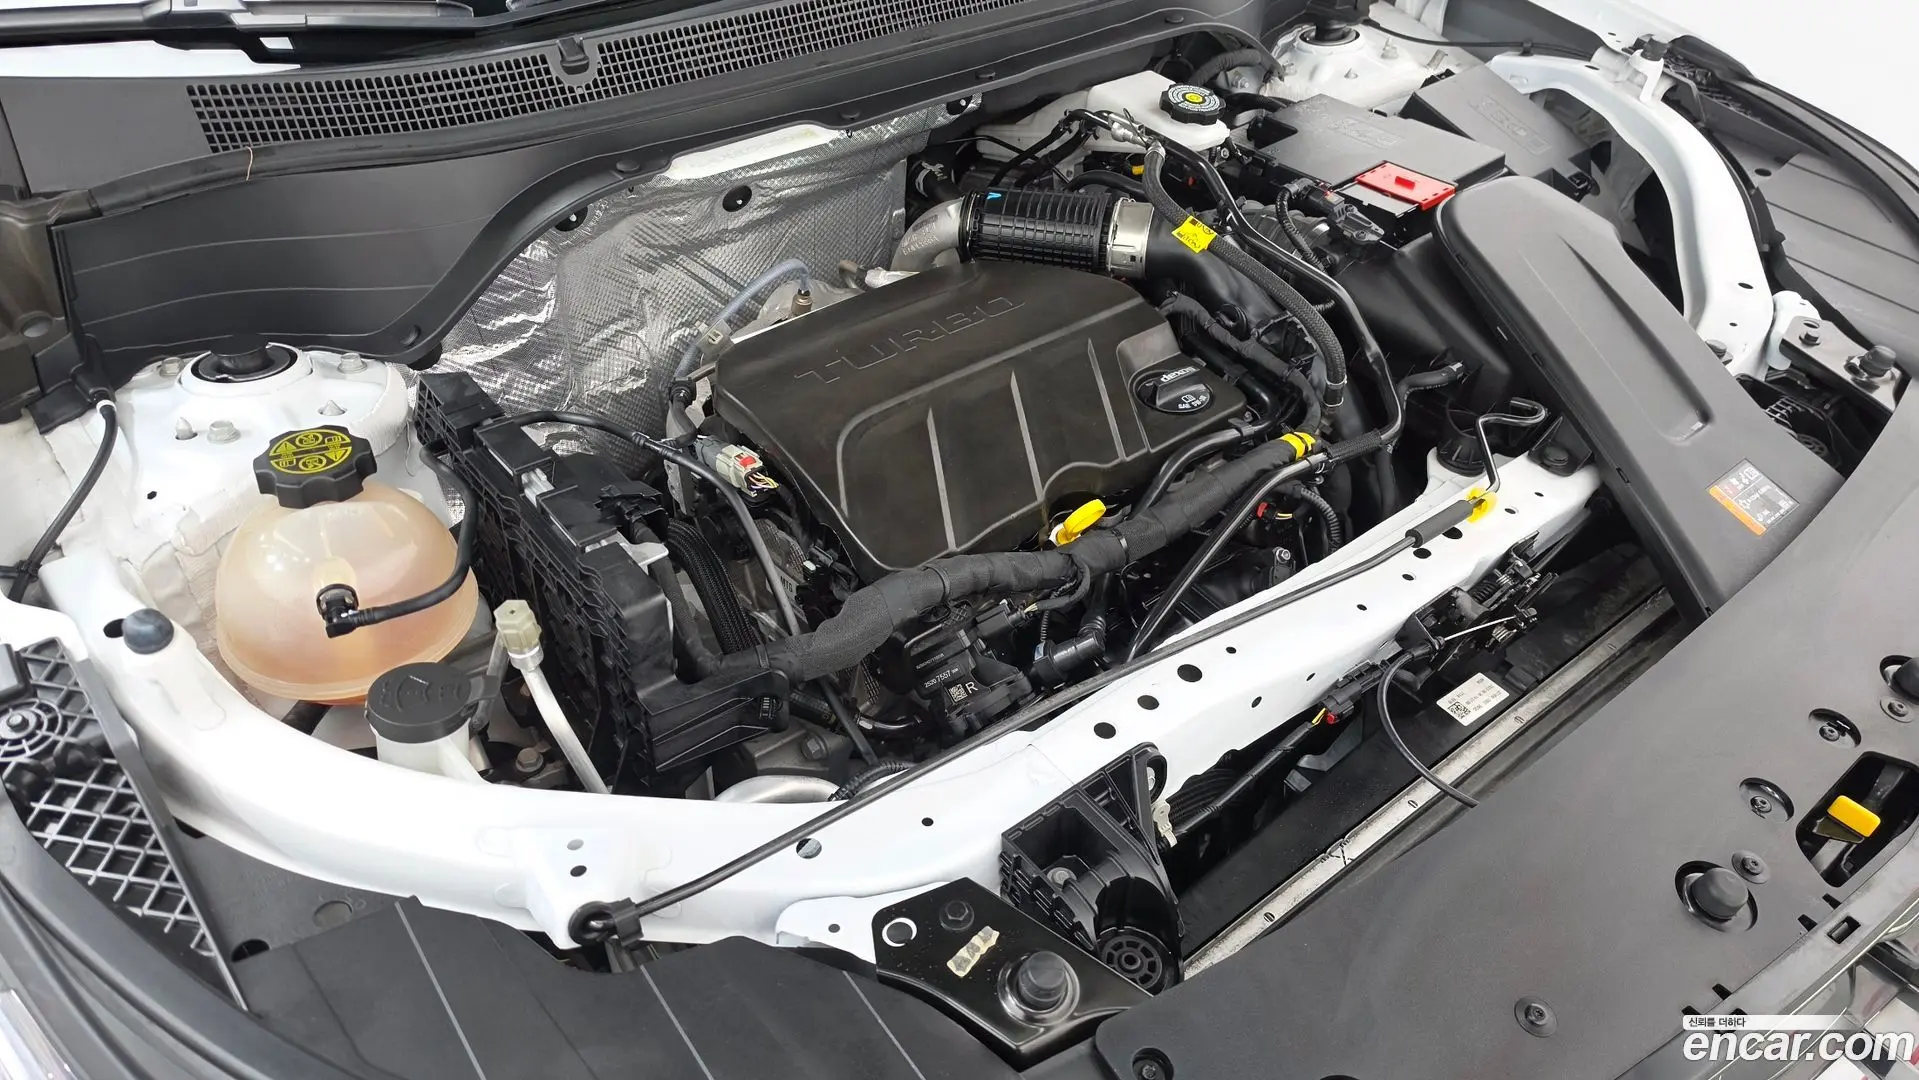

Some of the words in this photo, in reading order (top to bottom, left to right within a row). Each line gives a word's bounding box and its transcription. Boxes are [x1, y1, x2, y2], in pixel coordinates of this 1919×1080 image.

[794, 297, 1025, 384] TURBO
[1160, 366, 1197, 382] dexos
[965, 681, 979, 694] R
